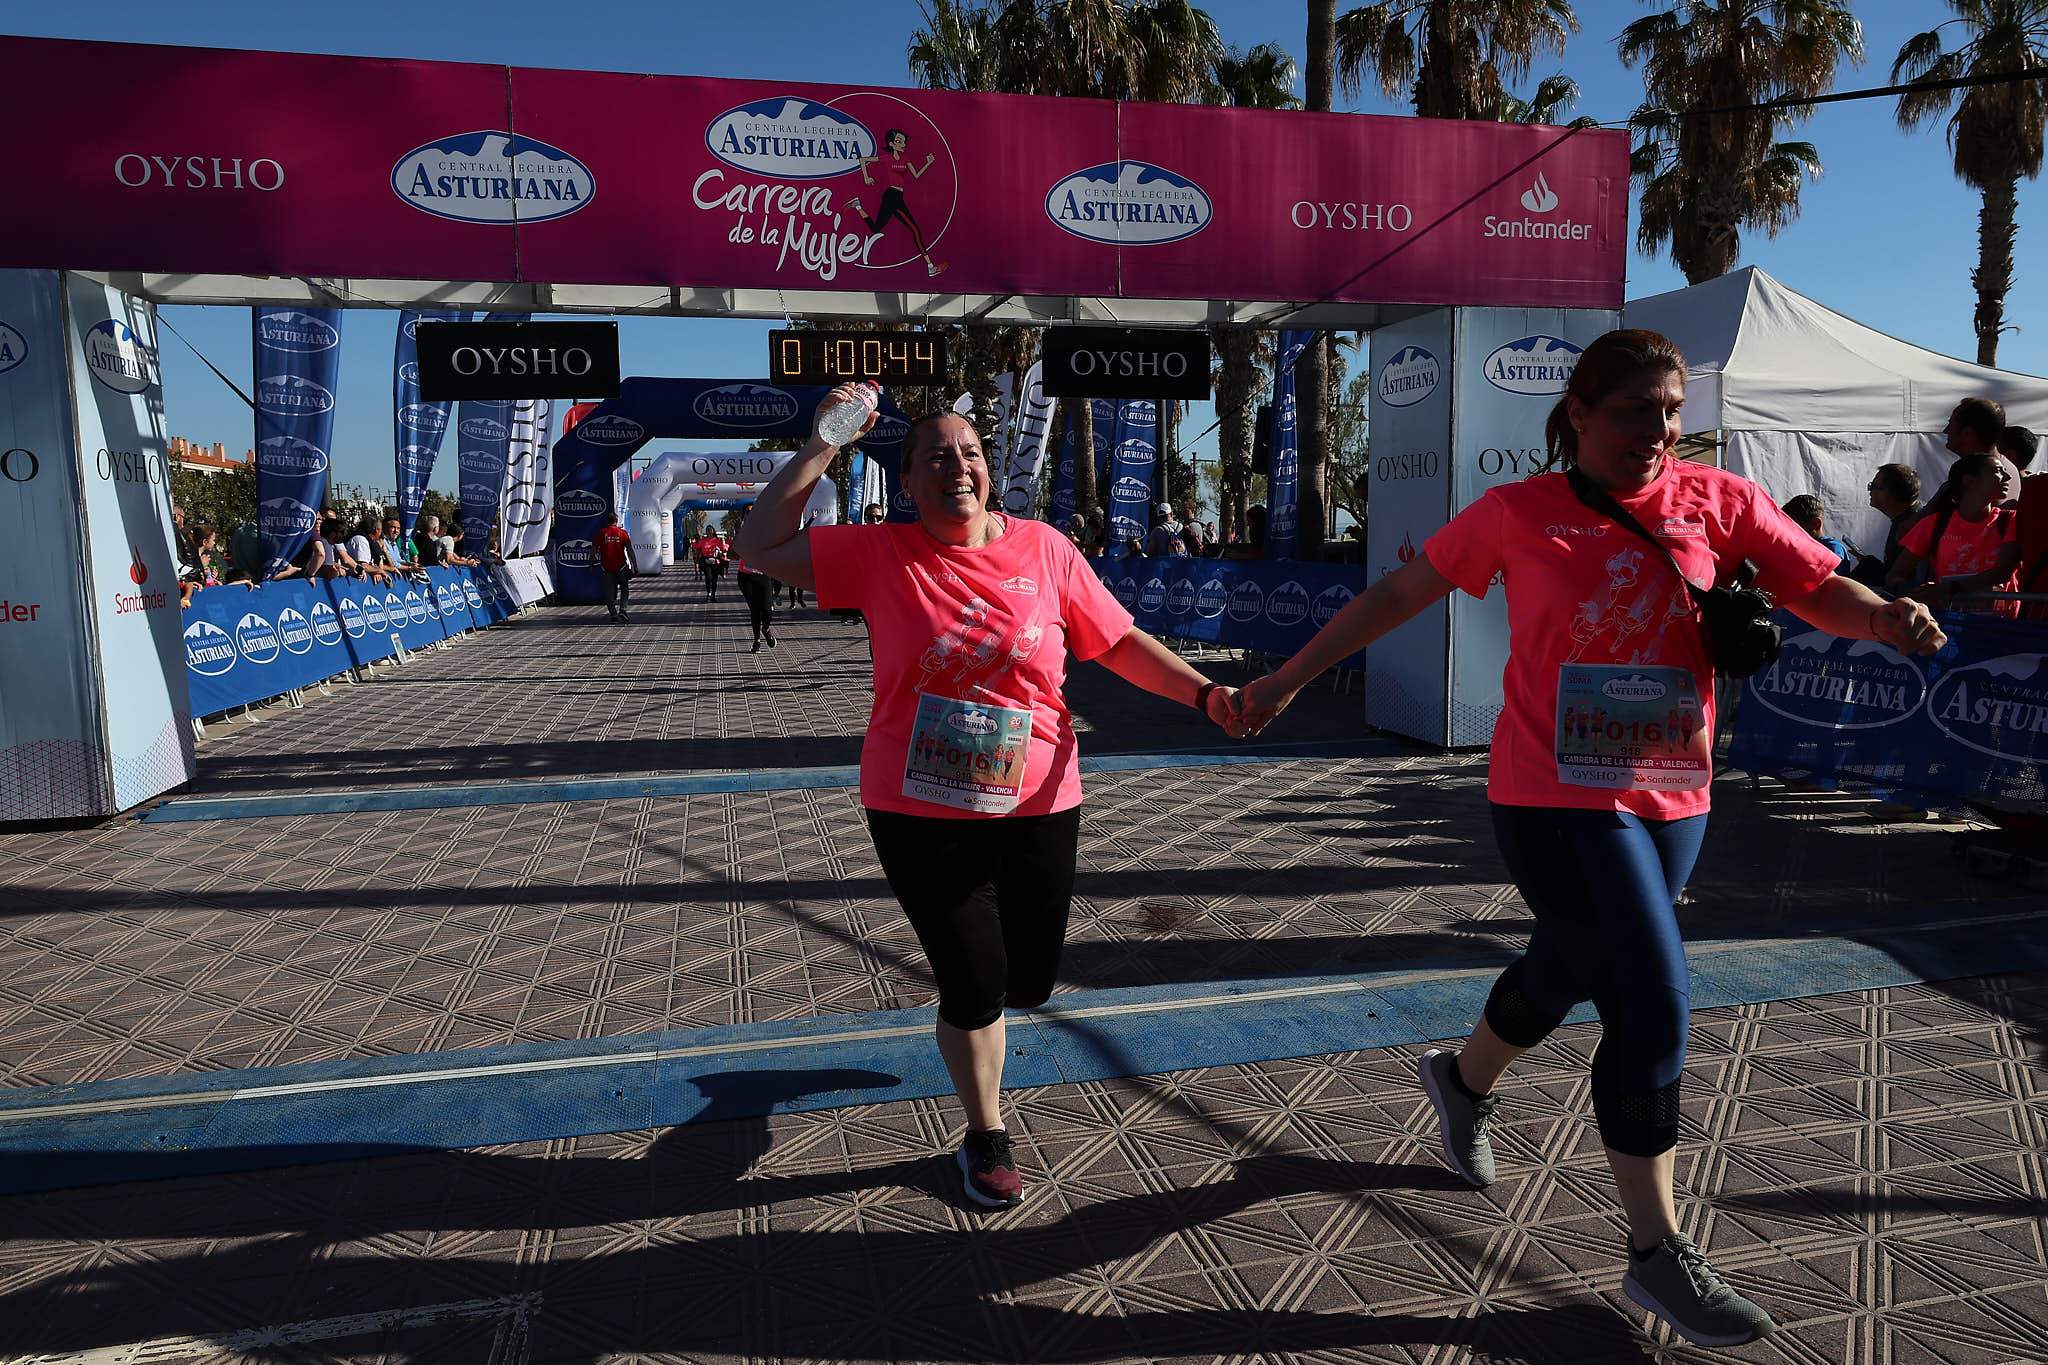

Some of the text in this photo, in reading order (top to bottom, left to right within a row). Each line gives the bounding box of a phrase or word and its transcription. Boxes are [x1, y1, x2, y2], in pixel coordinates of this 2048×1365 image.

[745, 122, 859, 137] CENTRAL LECHERA
[719, 122, 864, 161] ASTURIANA
[114, 153, 285, 191] OYSHO
[438, 161, 502, 173] CENTRAL
[408, 162, 581, 201] ASTURIANA
[692, 168, 833, 217] Carrera
[1084, 188, 1195, 200] CENTRAL LECHERA
[1058, 188, 1200, 225] ASTURIANA
[1290, 200, 1413, 232] OYSHO
[1482, 215, 1593, 242] Santander
[728, 213, 886, 281] de la Mujer
[451, 347, 593, 376] OYSHO
[1070, 349, 1188, 378] OYSHO
[1381, 370, 1435, 397] ASTURIANA
[701, 396, 791, 417] ASTURIANA
[580, 426, 639, 439] ASTURIANA
[97, 448, 161, 485] OYSHO
[692, 458, 774, 476] OYSHO
[1377, 451, 1438, 482] OYSHO
[556, 502, 603, 512] ASTURIANA
[114, 589, 167, 615] Santander
[186, 643, 235, 666] ASTURIANA
[240, 633, 278, 654] ASTURIANA
[1606, 682, 1664, 697] ASTURIANA
[1758, 657, 1907, 711] ASTURIANA
[1606, 720, 1662, 741] 016
[946, 748, 990, 770] 016
[1563, 755, 1600, 765] CARRERA
[1601, 757, 1612, 766] DE
[1614, 757, 1625, 766] LA
[1626, 757, 1654, 768] MUJER
[1661, 759, 1699, 769] VALENCIA
[1621, 746, 1641, 757] 918
[911, 771, 939, 783] CARRERA
[939, 776, 949, 786] DE
[949, 778, 958, 788] LA
[959, 780, 981, 792] MUJER
[985, 784, 1014, 796] VALENCIA
[1571, 768, 1617, 782] OYSHO
[1646, 775, 1692, 785] Santander
[914, 784, 951, 800] OYSHO
